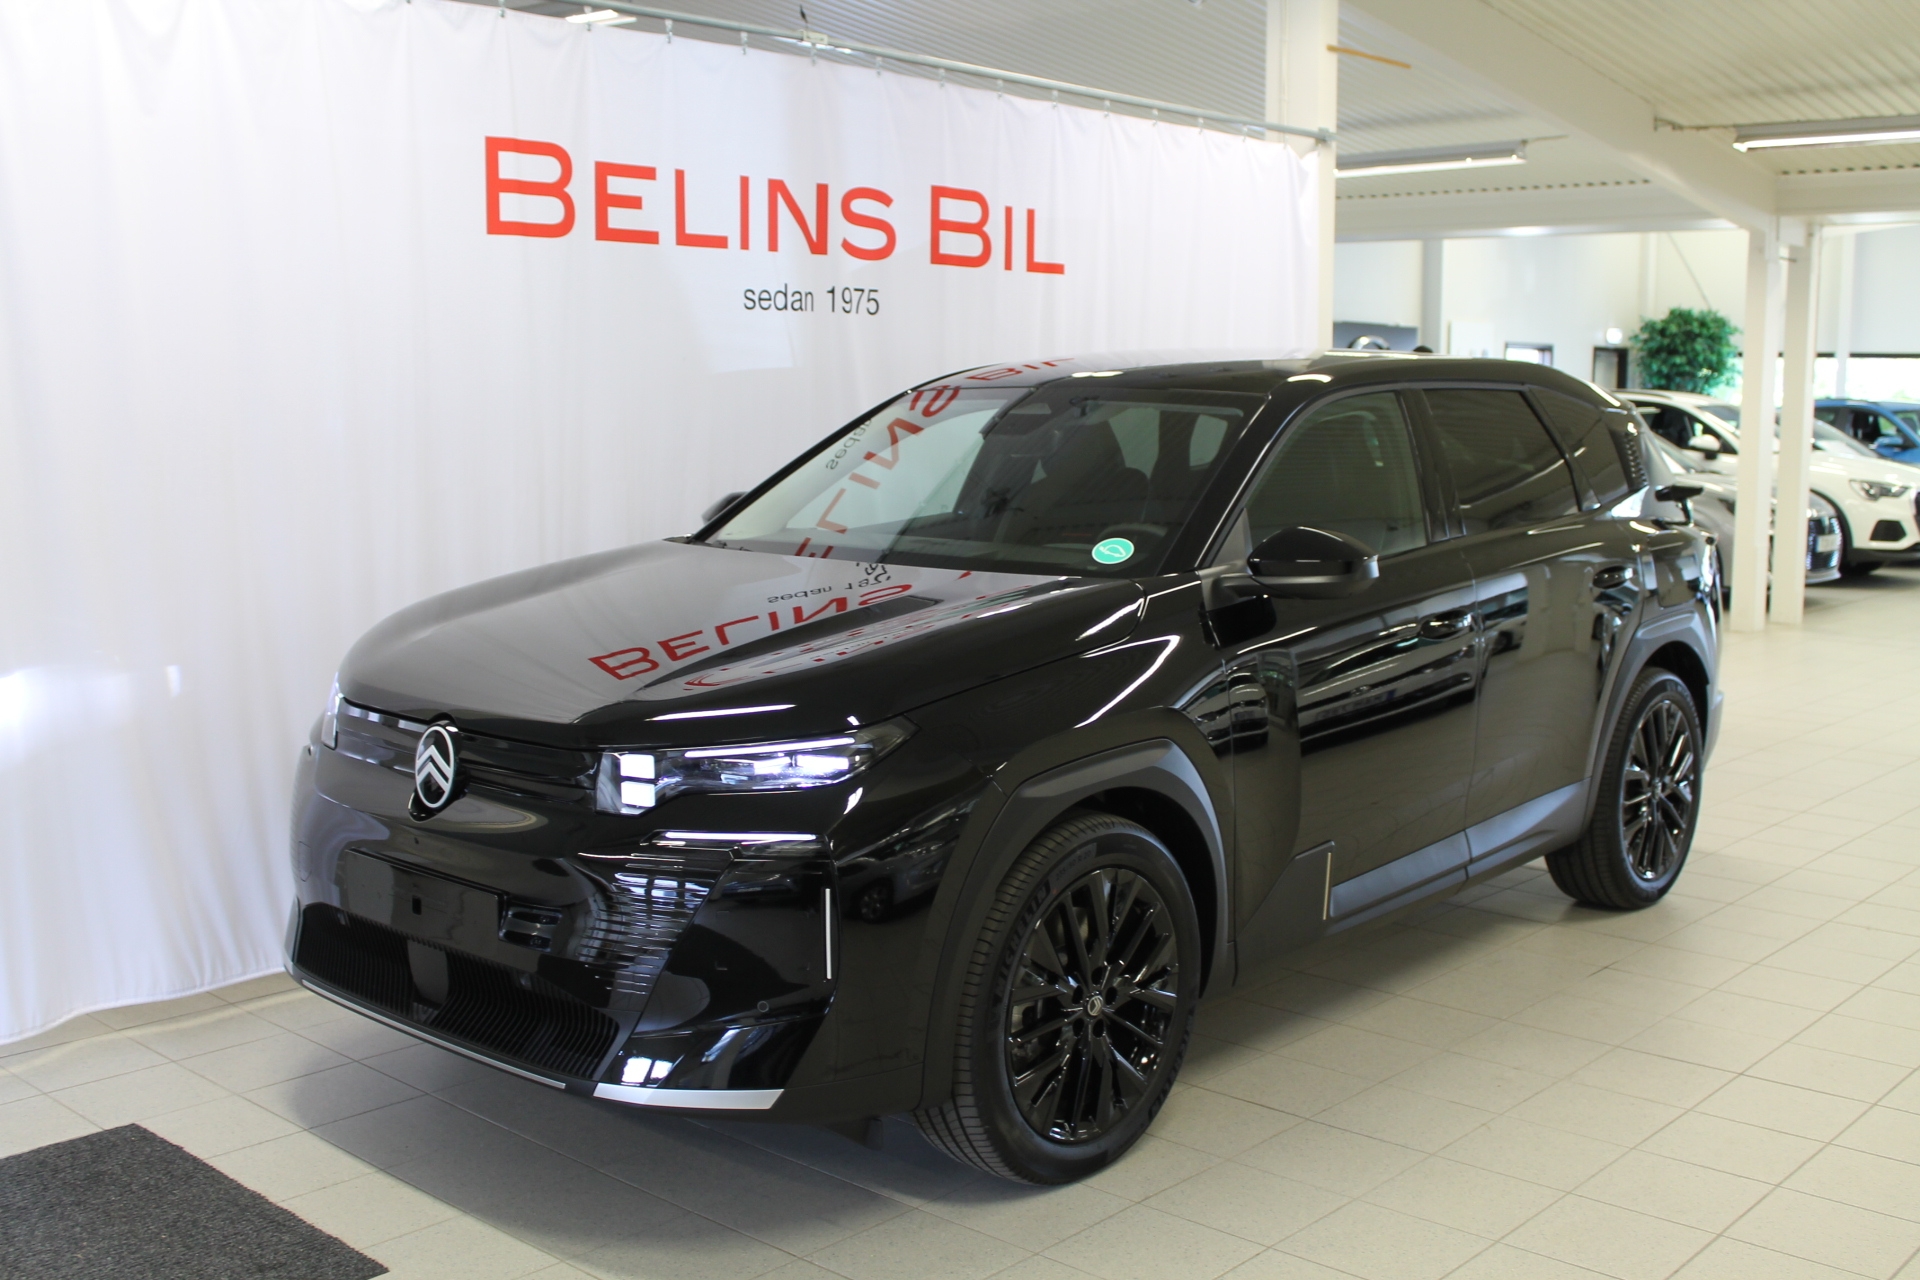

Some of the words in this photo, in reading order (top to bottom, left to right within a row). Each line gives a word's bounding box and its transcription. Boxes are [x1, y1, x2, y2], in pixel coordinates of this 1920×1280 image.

[485, 136, 897, 261] BELINS
[930, 185, 1065, 275] BIL
[743, 284, 814, 312] sedan
[826, 286, 880, 316] 1975
